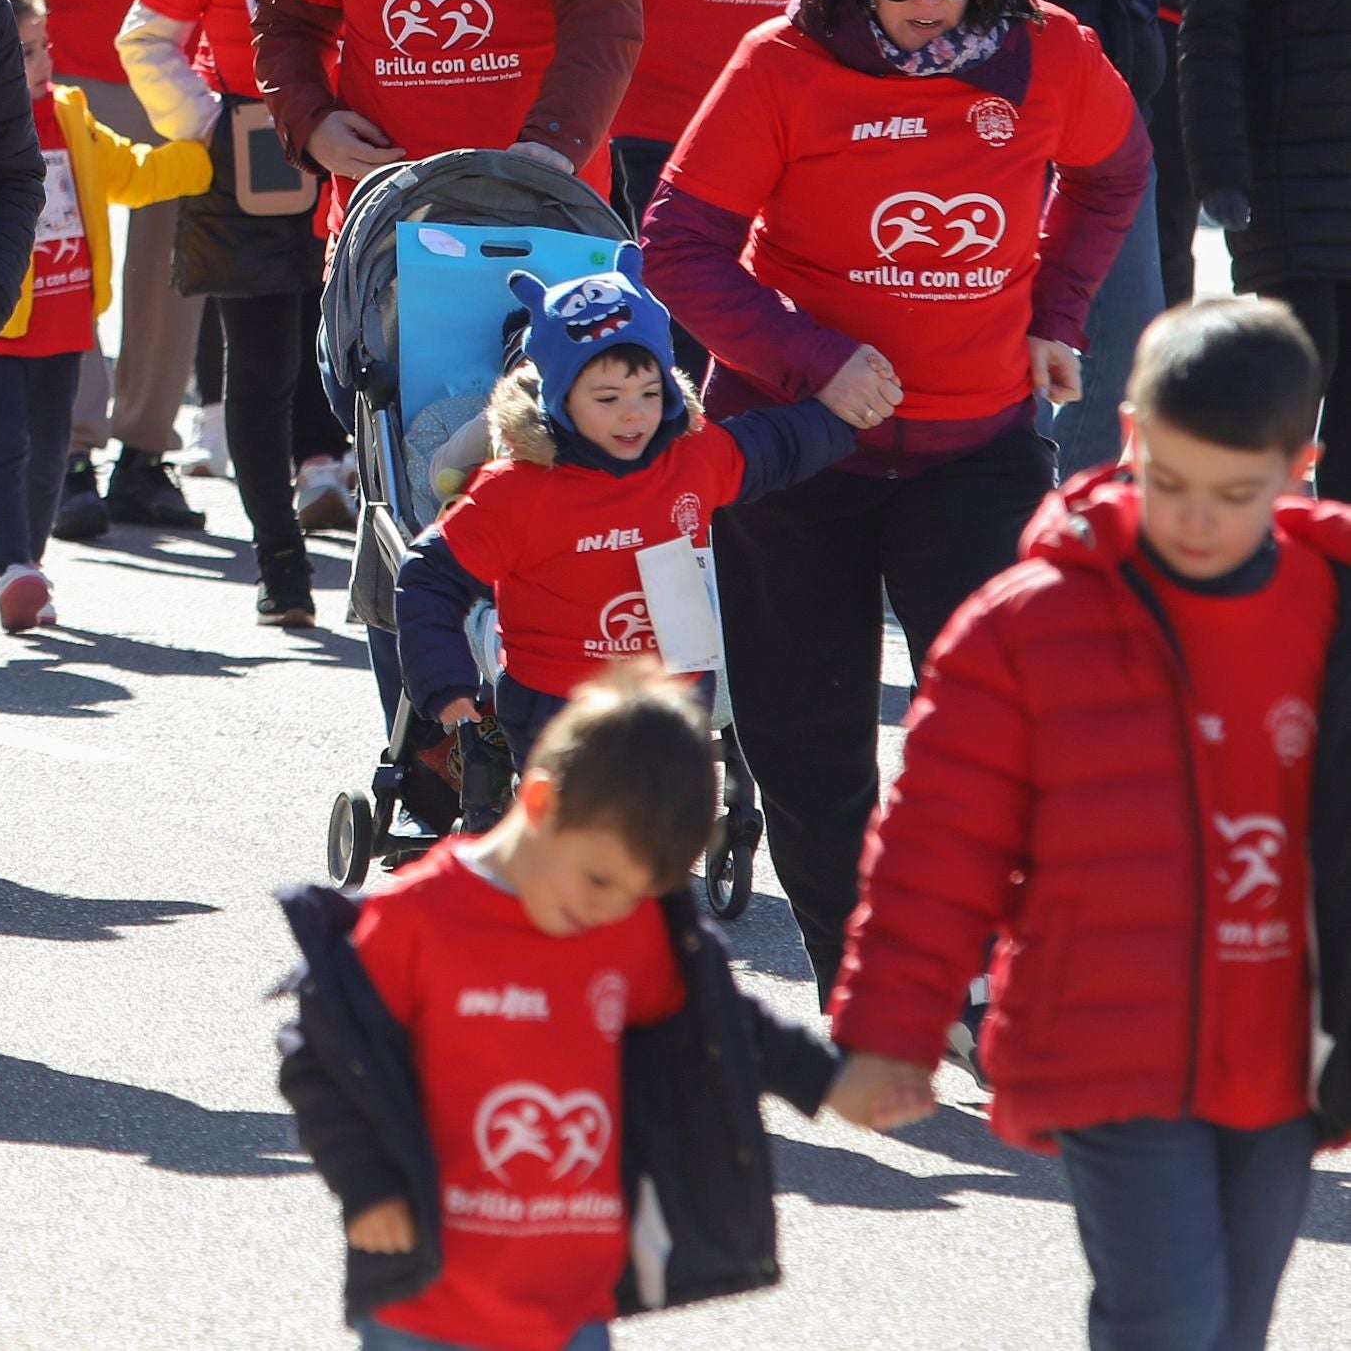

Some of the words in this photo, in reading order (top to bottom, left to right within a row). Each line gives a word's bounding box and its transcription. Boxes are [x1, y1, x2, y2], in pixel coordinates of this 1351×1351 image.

[375, 56, 427, 76] Brilla
[431, 58, 466, 75] con
[470, 52, 520, 72] ellos
[851, 116, 929, 141] INAEL
[920, 269, 960, 289] con
[576, 528, 644, 553] INAEL
